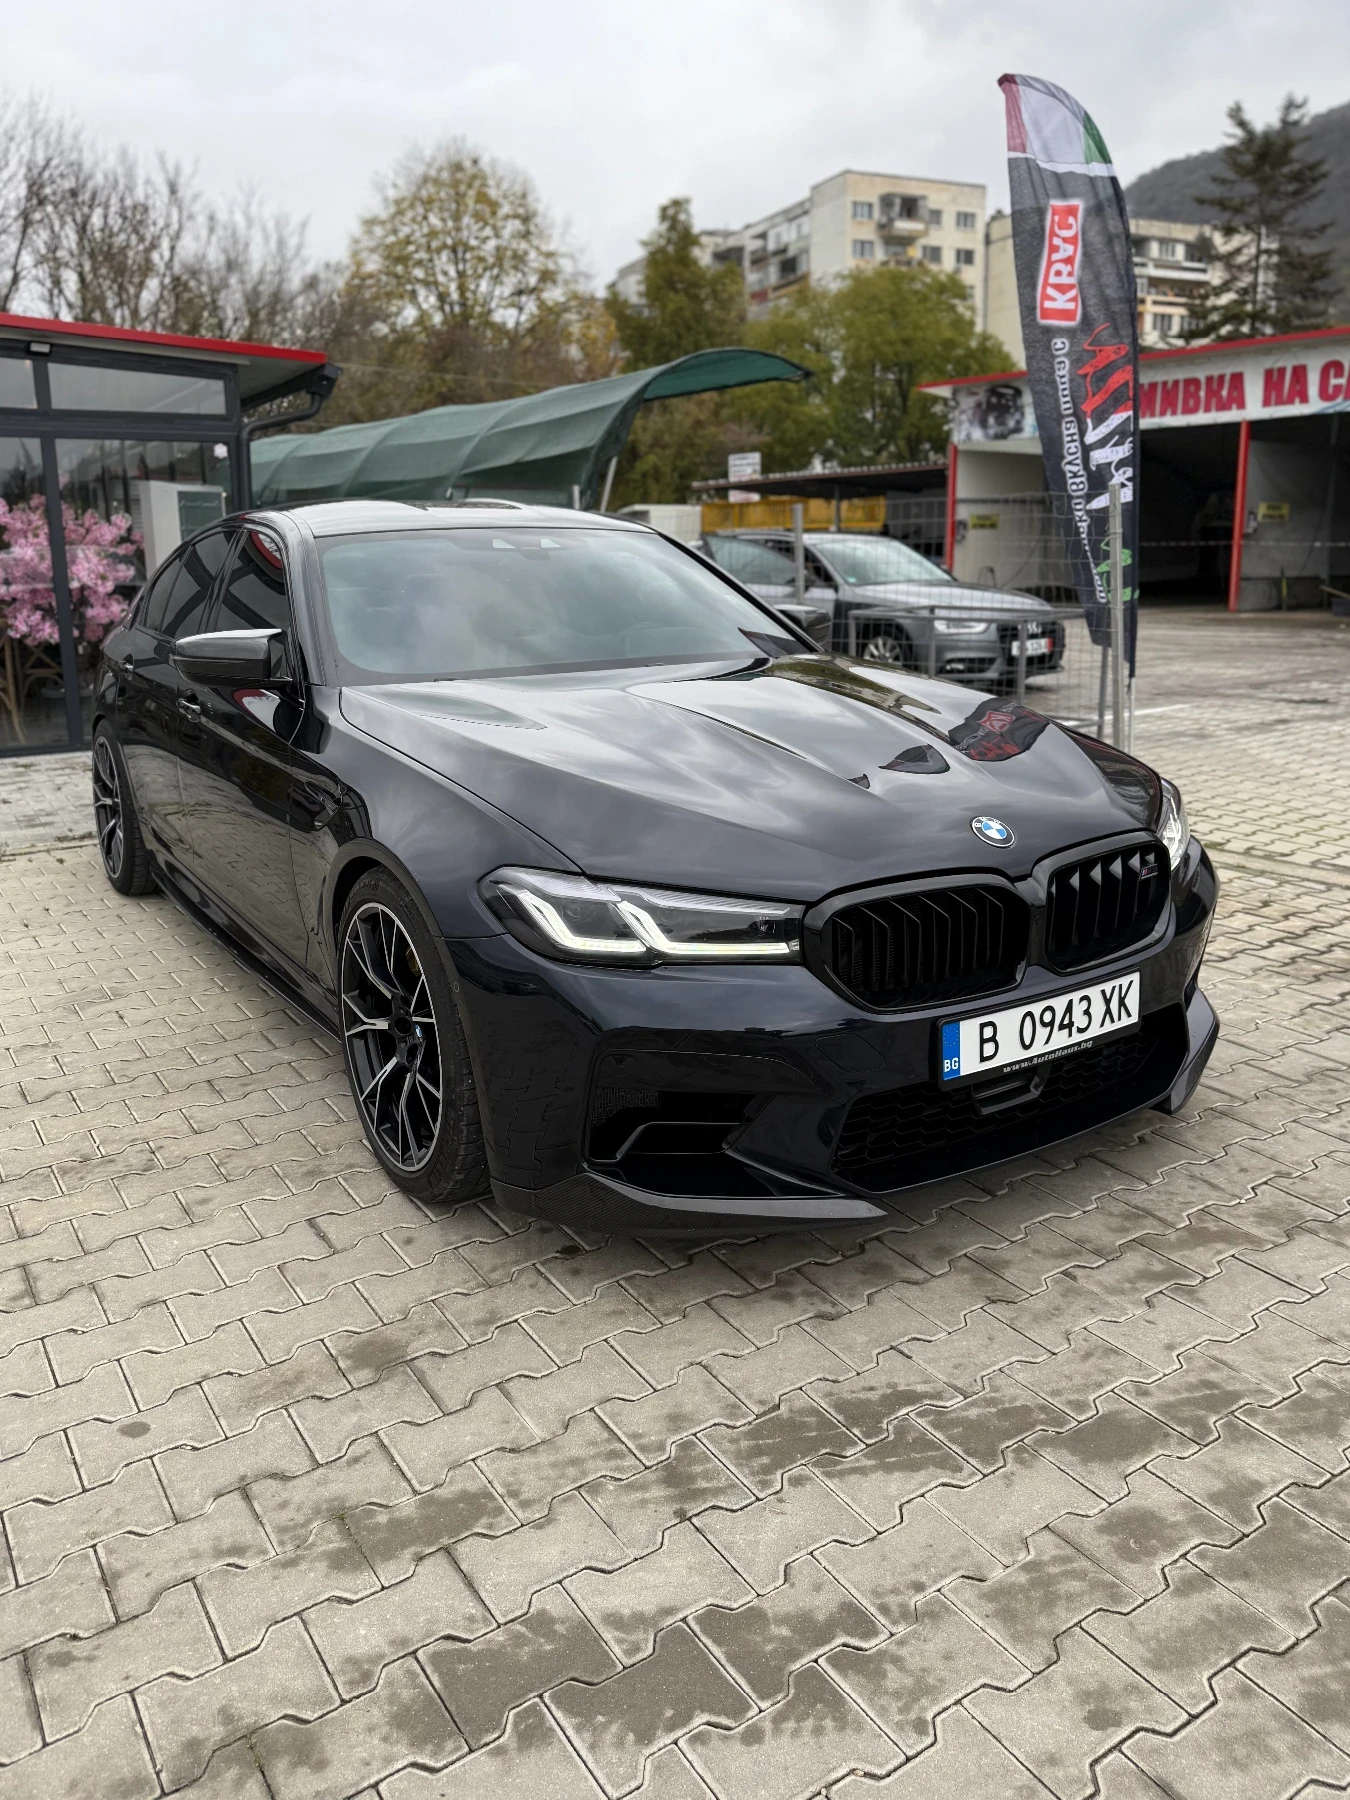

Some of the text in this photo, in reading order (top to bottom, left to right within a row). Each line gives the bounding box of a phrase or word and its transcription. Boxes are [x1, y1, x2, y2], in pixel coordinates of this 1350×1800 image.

[1262, 364, 1309, 408] НА
[979, 979, 1134, 1064] B 0943 XK
[943, 1057, 959, 1072] BG
